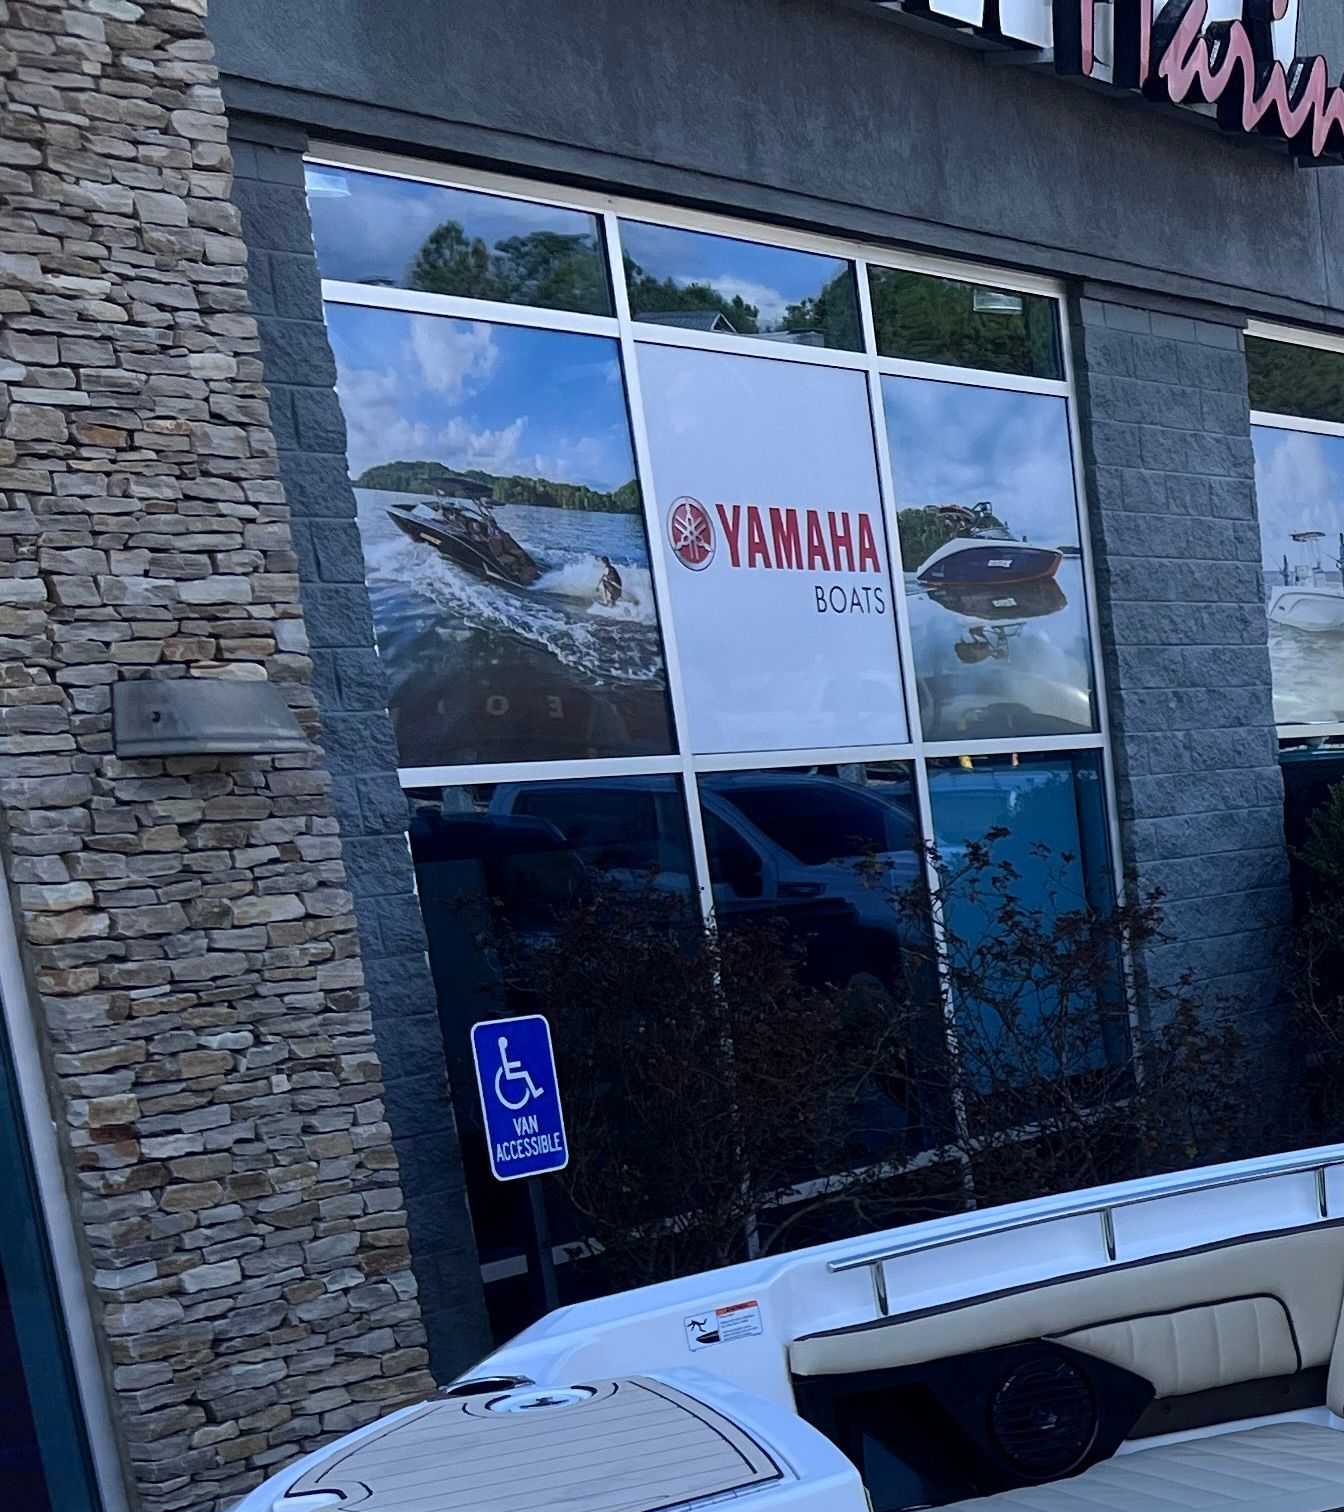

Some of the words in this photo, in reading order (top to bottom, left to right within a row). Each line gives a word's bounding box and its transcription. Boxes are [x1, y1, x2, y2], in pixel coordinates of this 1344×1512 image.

[714, 503, 881, 573] YAMAHA
[814, 585, 886, 615] BOATS
[512, 1114, 539, 1137] VAN
[496, 1131, 563, 1163] ACCESSIBLE
